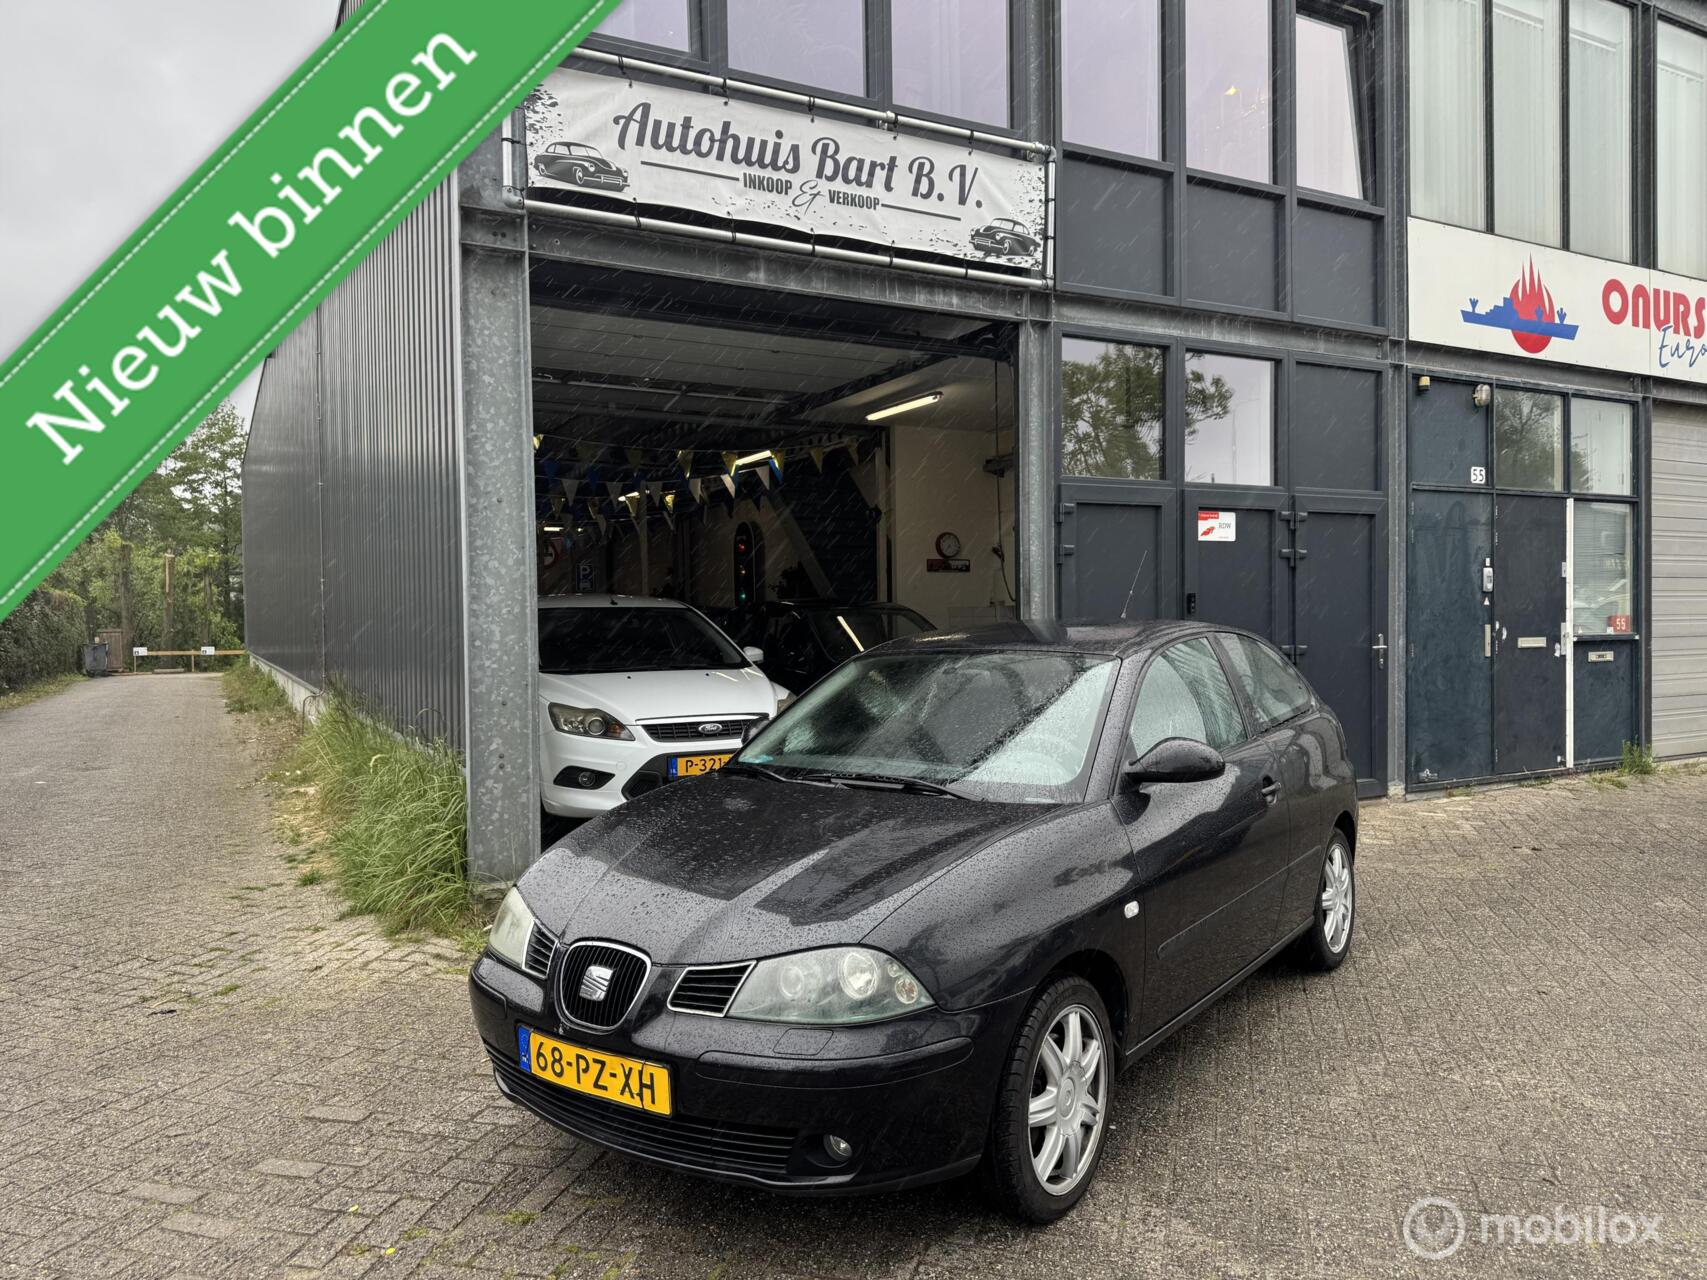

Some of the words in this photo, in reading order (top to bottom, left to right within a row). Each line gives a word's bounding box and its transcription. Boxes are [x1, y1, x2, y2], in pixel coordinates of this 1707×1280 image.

[613, 102, 801, 174] Autohuis
[811, 137, 898, 193] Bart
[908, 156, 983, 209] B.V.
[743, 172, 793, 196] INKOOP
[828, 189, 880, 211] VERKOOP
[1473, 468, 1484, 482] 55
[1615, 617, 1627, 631] 55
[536, 1041, 656, 1105] 68-PZ-XH
